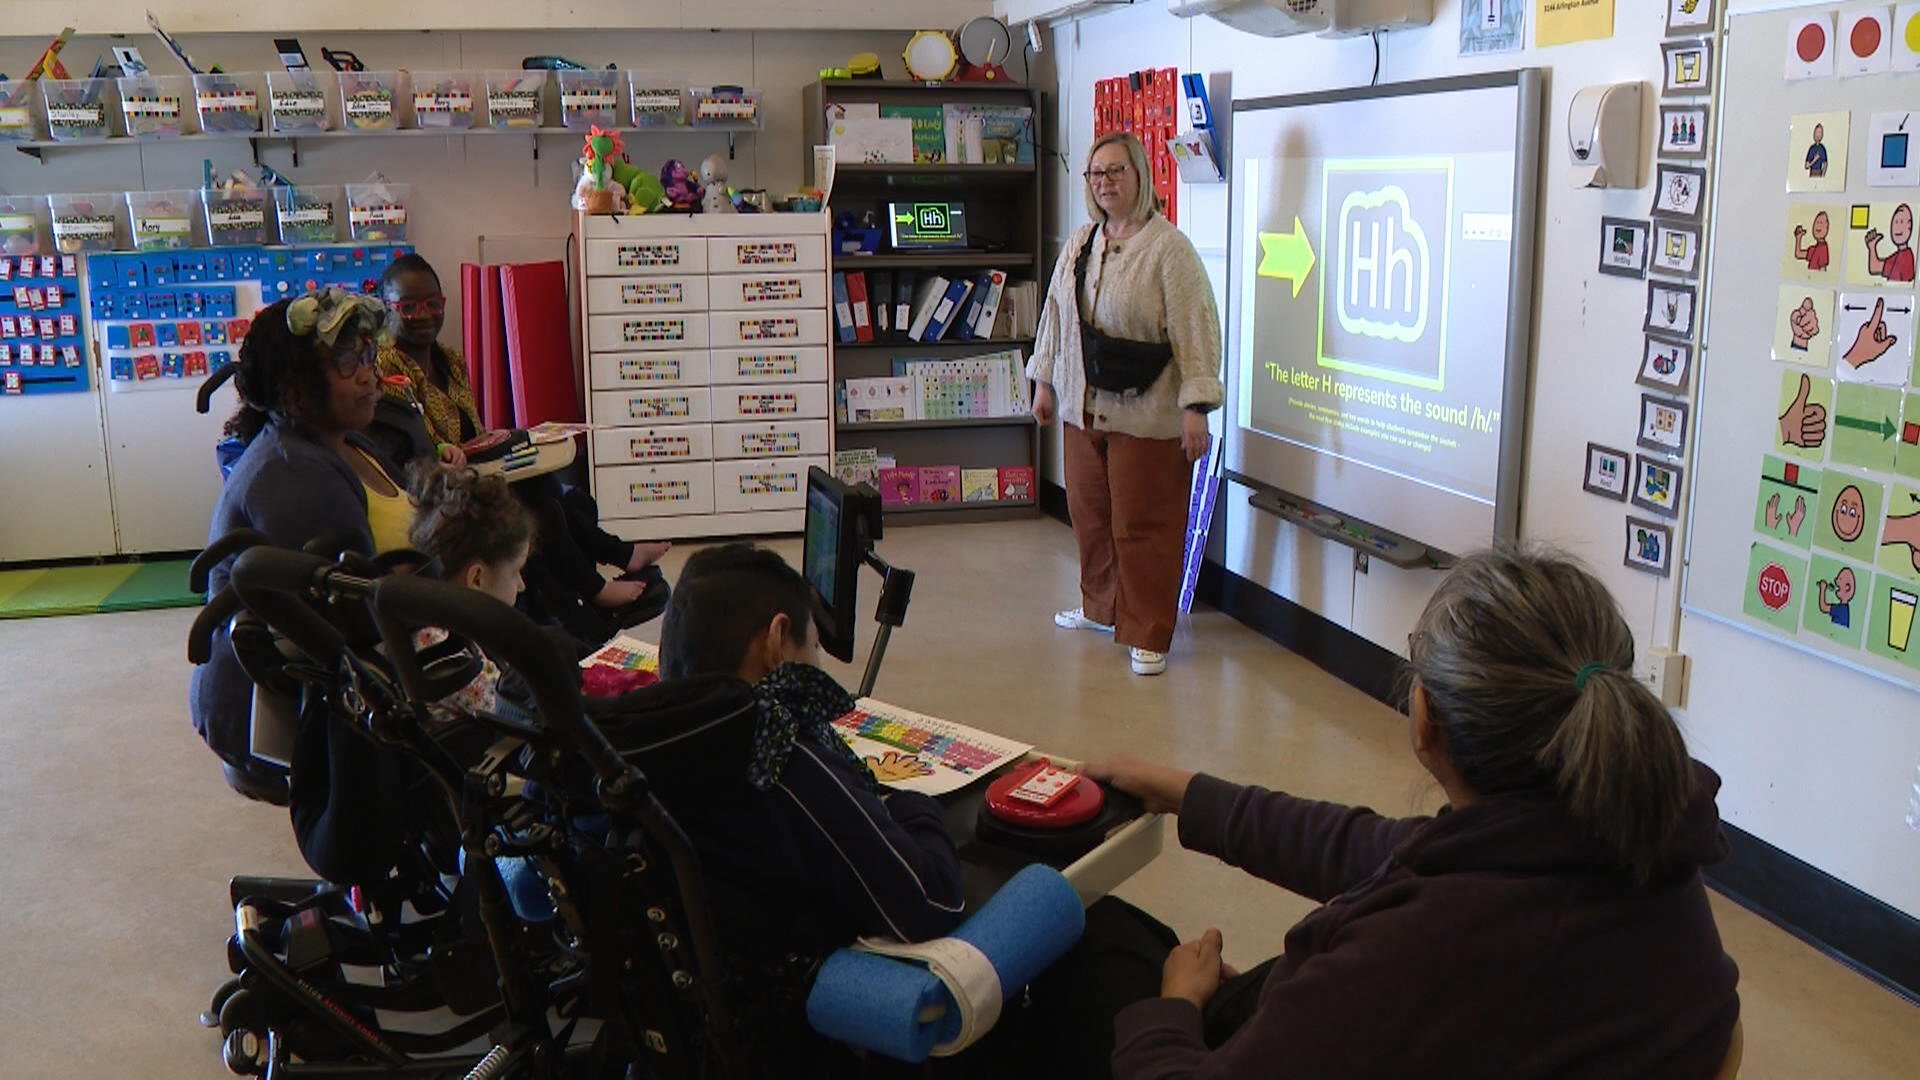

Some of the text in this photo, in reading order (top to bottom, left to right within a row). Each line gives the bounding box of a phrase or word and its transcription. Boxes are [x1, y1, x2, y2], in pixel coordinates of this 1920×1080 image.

[1350, 216, 1413, 313] Hh
[1265, 361, 1288, 384] “The
[1291, 367, 1320, 392] letter
[1322, 374, 1332, 394] H
[1334, 382, 1397, 410] represents
[1400, 392, 1422, 416] the
[1425, 404, 1468, 427] sound
[1760, 576, 1788, 598] STOP
